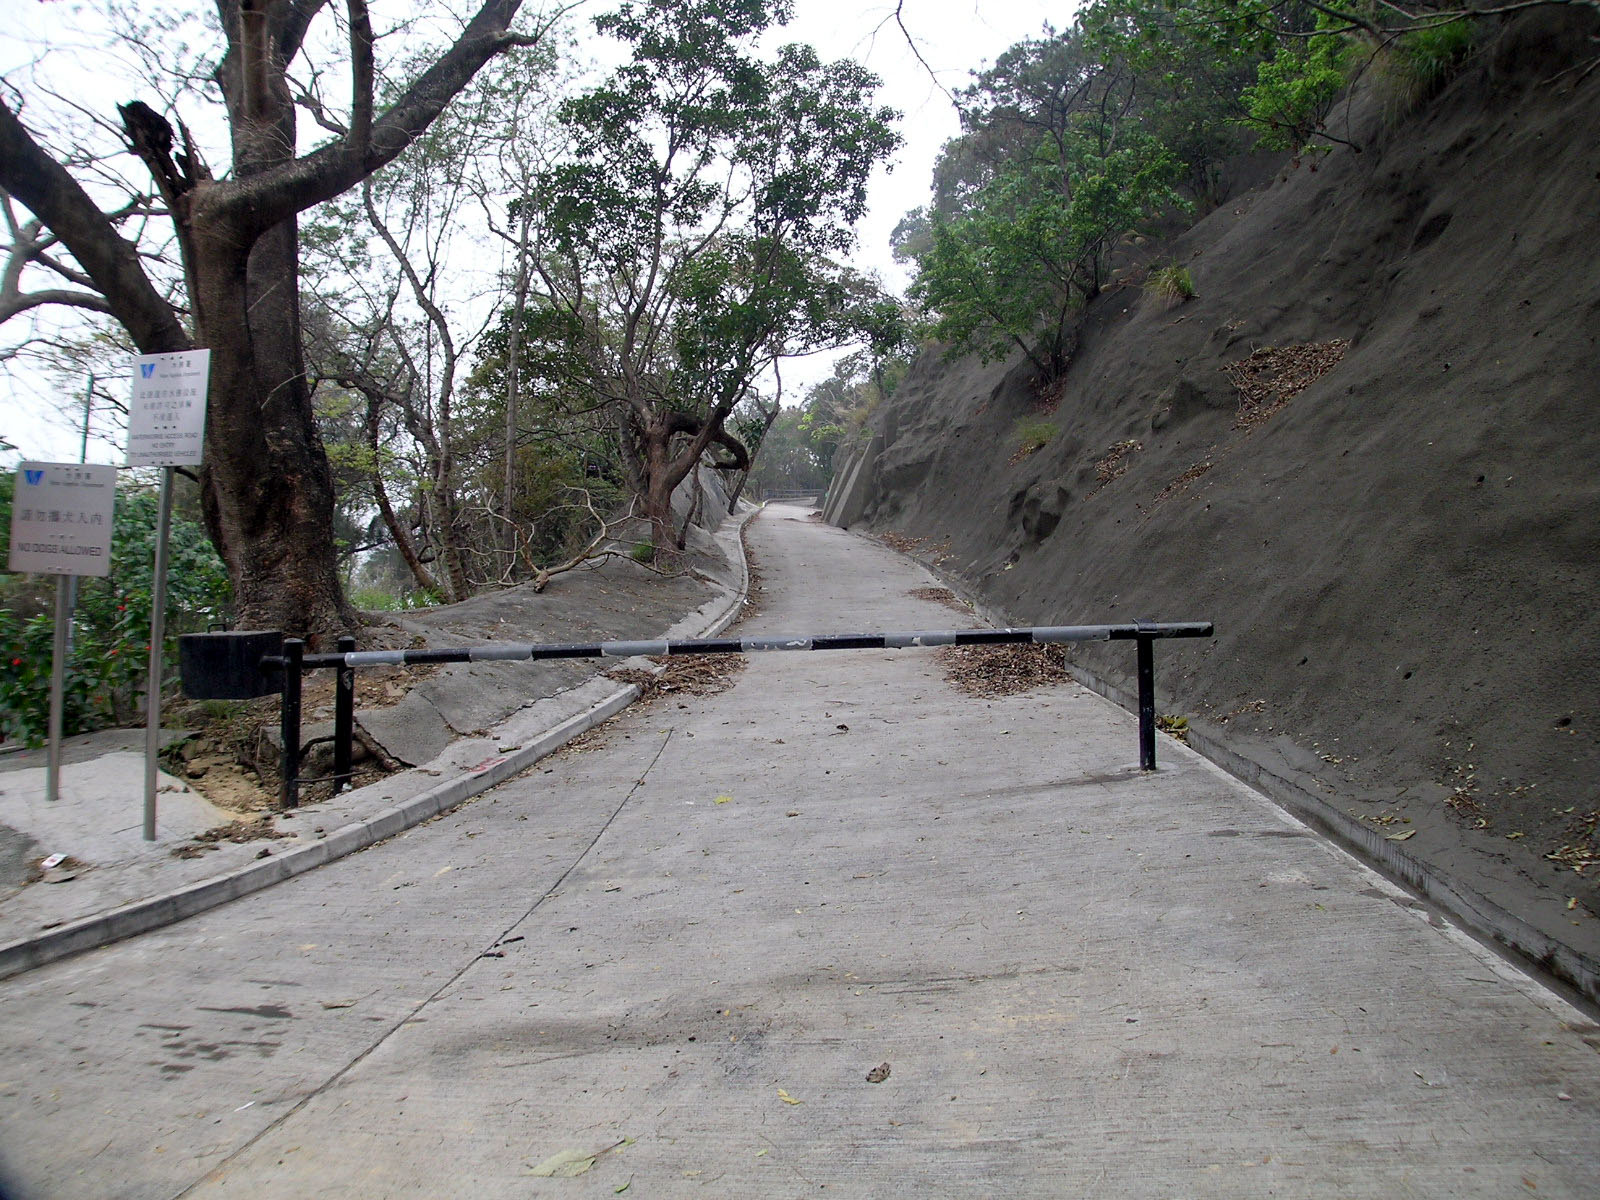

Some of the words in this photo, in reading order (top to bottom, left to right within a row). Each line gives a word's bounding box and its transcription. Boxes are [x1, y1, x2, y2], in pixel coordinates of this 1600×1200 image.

[18, 542, 31, 552] NO
[32, 543, 58, 554] DOGS
[60, 544, 102, 556] ALLOWED
